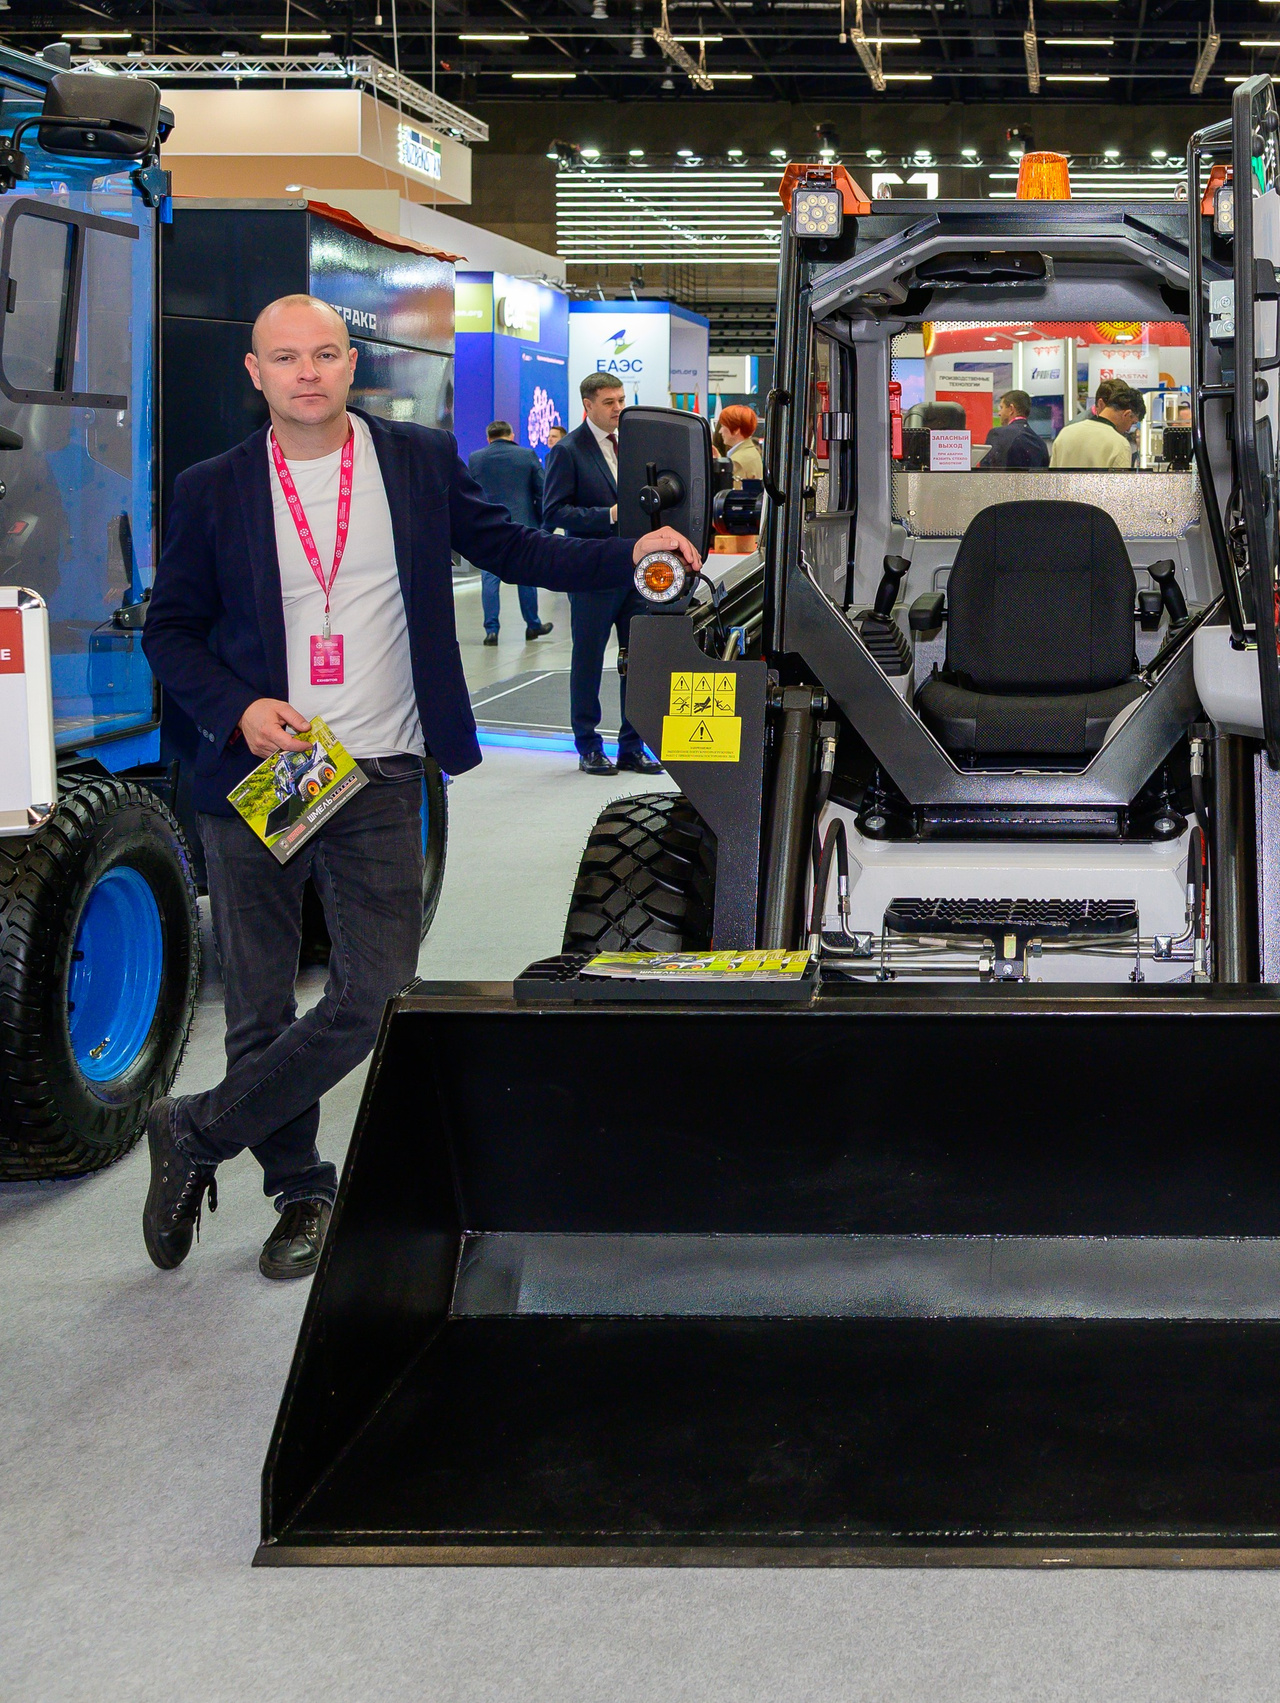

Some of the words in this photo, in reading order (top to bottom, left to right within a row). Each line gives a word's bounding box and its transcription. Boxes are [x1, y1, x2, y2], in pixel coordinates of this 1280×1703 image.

[330, 303, 377, 330] ТРАКС
[596, 359, 643, 373] ЕАЭС
[306, 796, 334, 824] ШМЕЛЬ
